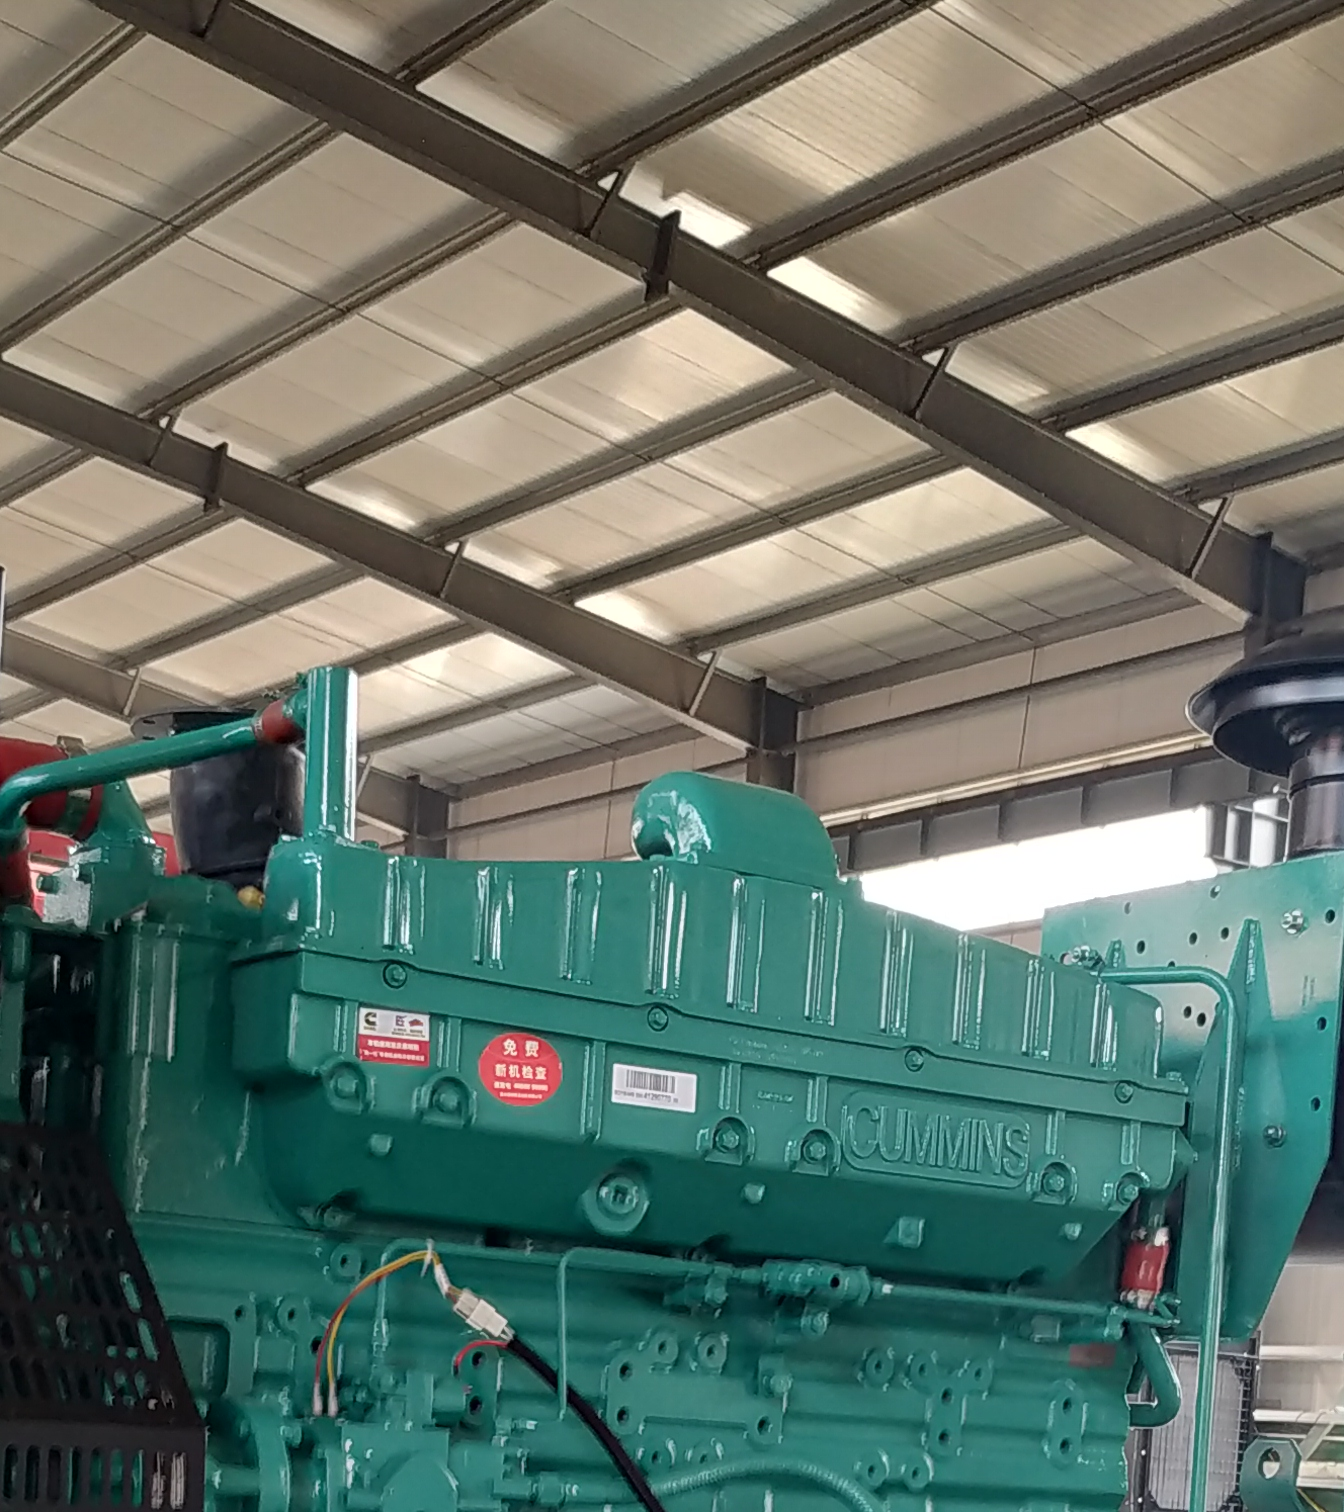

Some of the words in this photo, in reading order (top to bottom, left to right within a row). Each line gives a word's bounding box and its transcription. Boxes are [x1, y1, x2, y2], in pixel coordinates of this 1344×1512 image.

[503, 1038, 539, 1058] 免费
[495, 1063, 547, 1080] 新机检查
[847, 1105, 1028, 1179] CUMMINS
